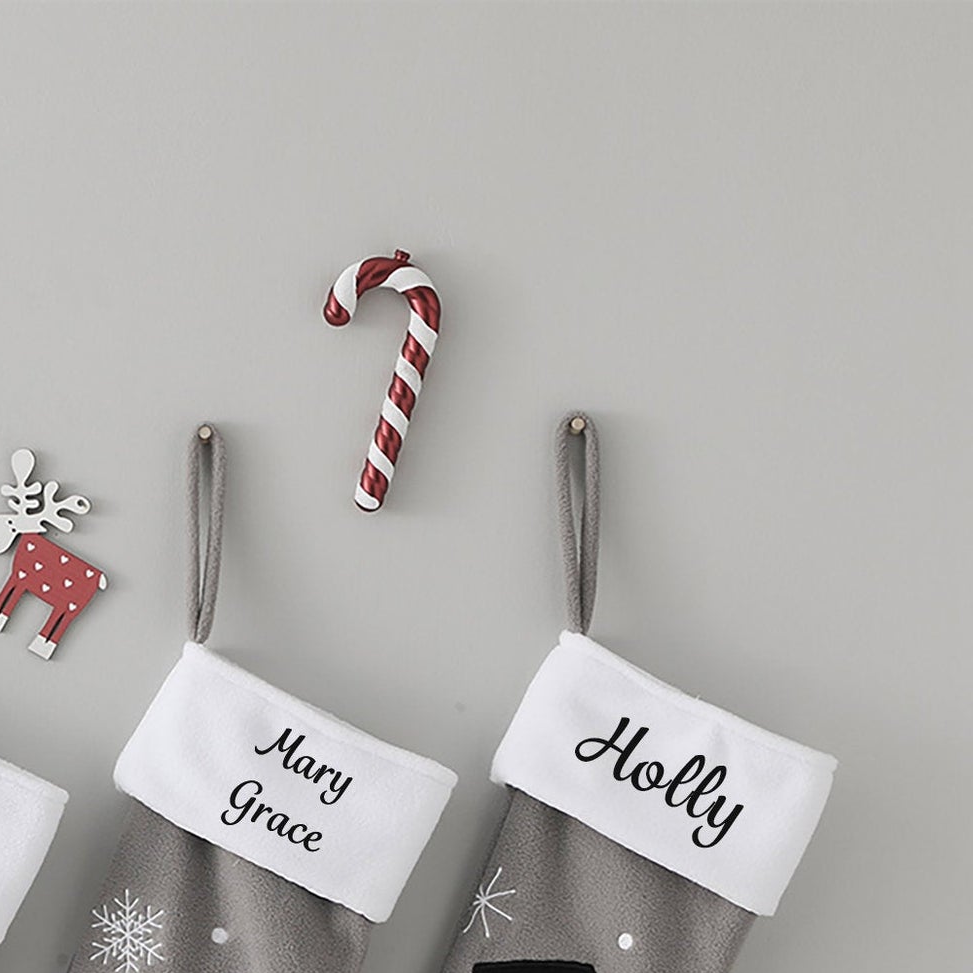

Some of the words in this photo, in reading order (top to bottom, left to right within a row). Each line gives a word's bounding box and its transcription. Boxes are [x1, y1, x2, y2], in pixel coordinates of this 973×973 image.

[254, 727, 354, 806] Mary
[574, 716, 745, 849] Holly
[220, 779, 324, 854] Grace
